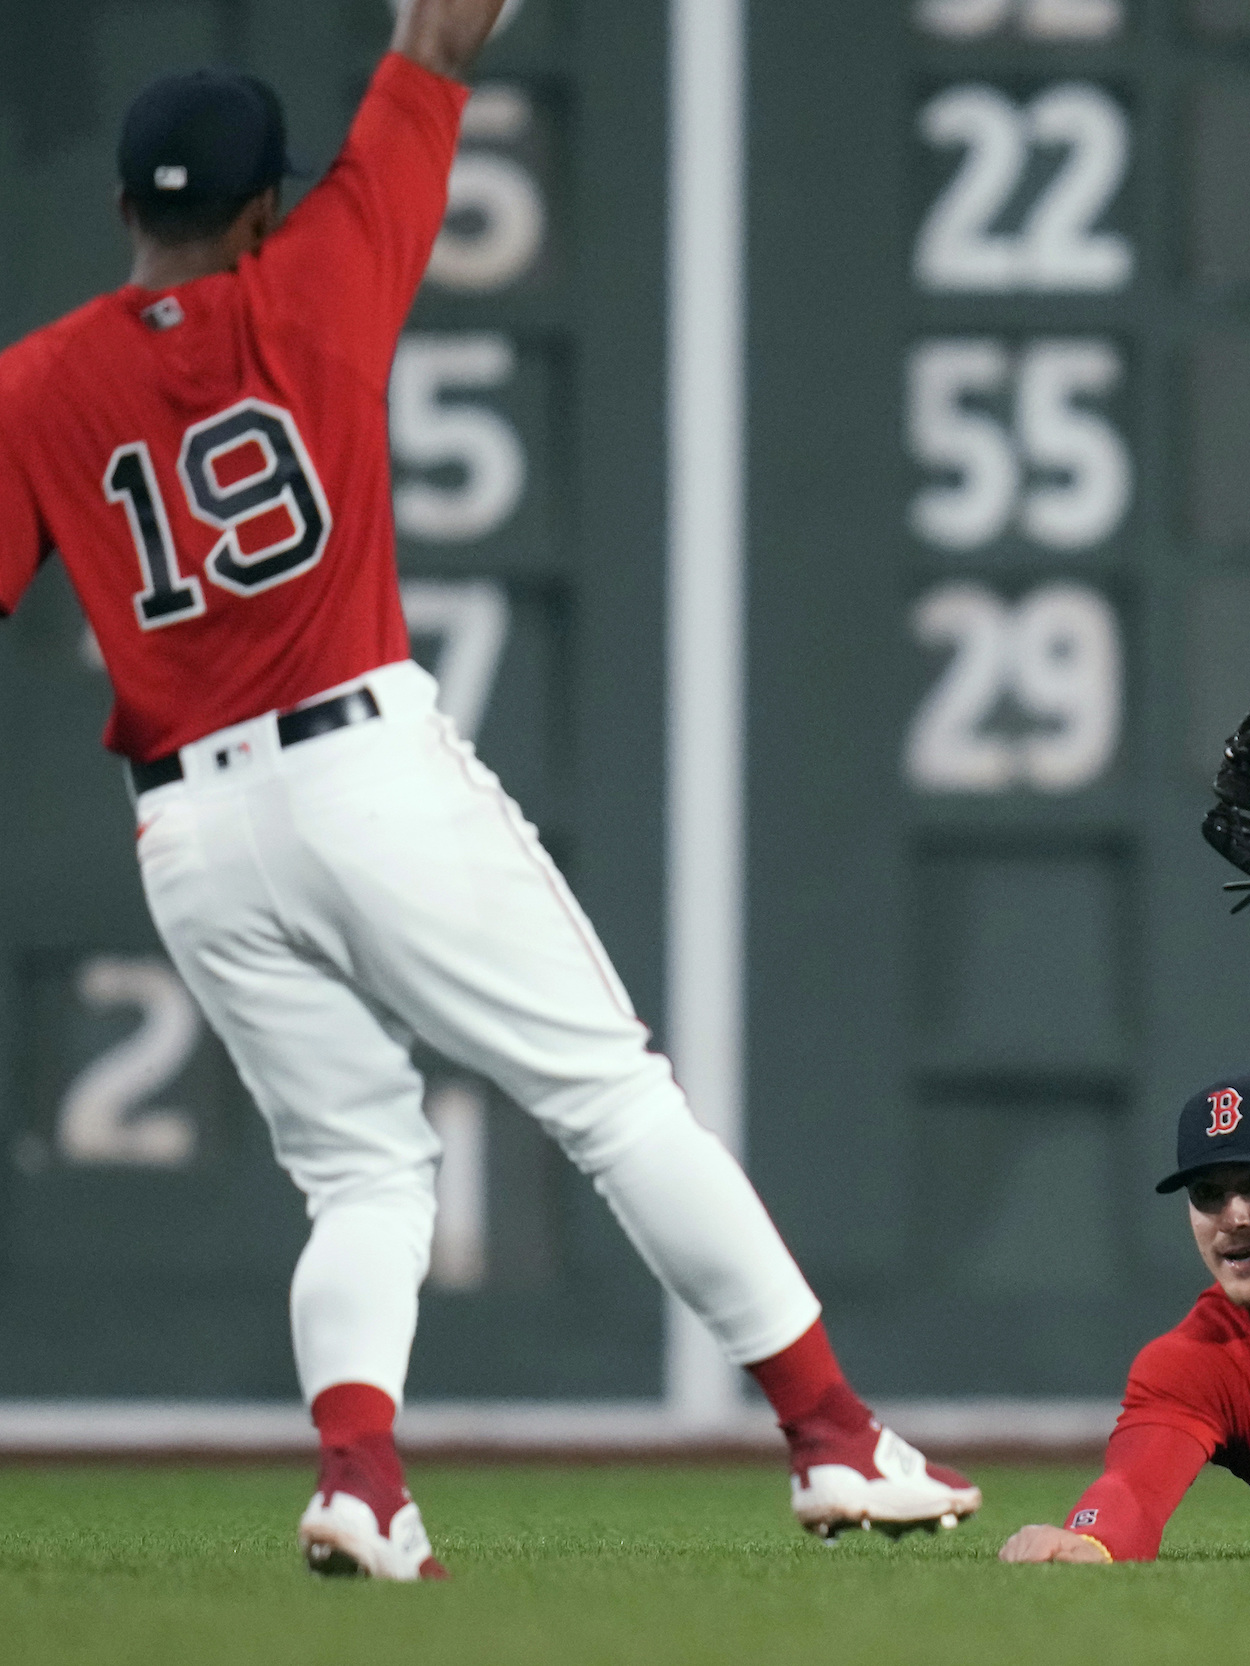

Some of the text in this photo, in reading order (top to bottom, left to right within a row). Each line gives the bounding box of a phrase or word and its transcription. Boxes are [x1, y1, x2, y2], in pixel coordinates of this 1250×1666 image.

[913, 84, 1135, 292] 22
[102, 396, 332, 631] 19
[387, 332, 528, 543] 5
[907, 338, 1132, 550] 55
[904, 578, 1124, 795] 29
[57, 955, 200, 1166] 2
[1206, 1087, 1243, 1137] B
